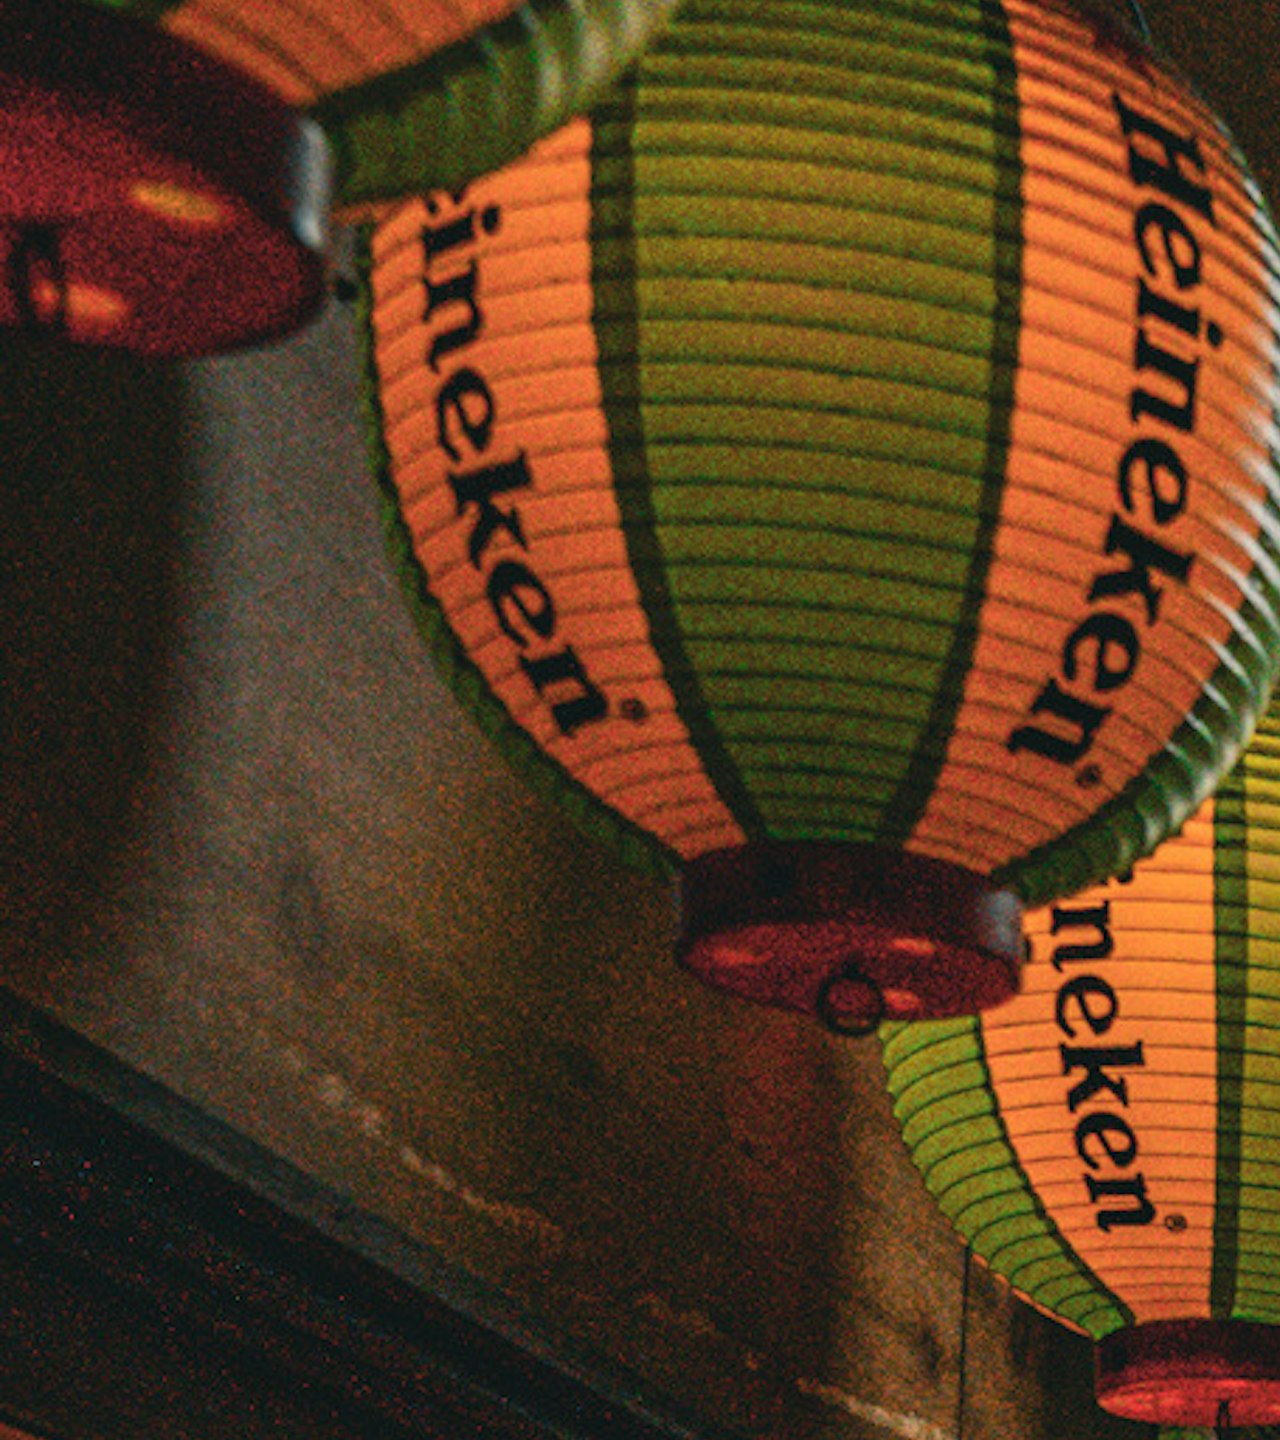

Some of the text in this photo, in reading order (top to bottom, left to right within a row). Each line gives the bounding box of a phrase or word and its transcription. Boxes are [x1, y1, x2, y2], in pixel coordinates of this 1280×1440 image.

[422, 192, 607, 734] ineken
[1004, 91, 1222, 762] Heineken
[1051, 872, 1155, 1232] neken
